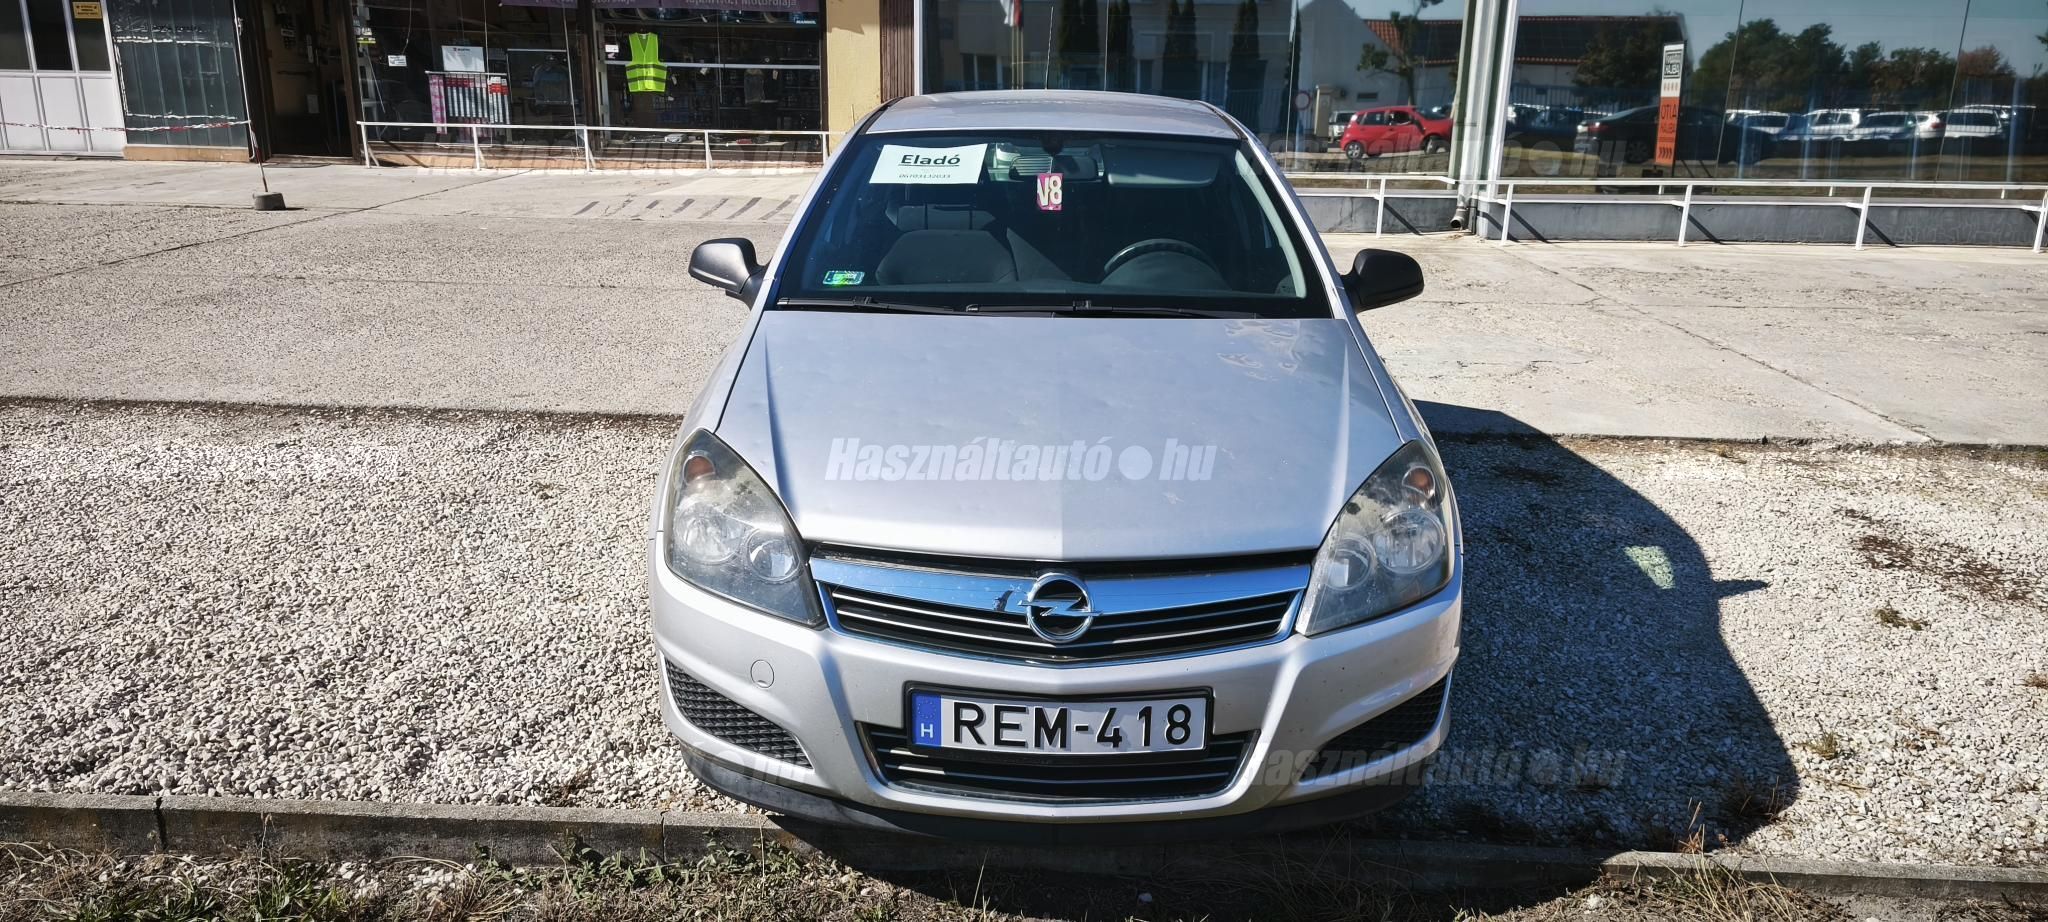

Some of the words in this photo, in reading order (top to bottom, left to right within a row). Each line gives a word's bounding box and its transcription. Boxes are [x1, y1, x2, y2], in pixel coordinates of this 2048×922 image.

[901, 154, 961, 165] Eladó
[1037, 175, 1062, 206] V8
[920, 723, 933, 738] H
[953, 701, 1192, 749] REM-418
